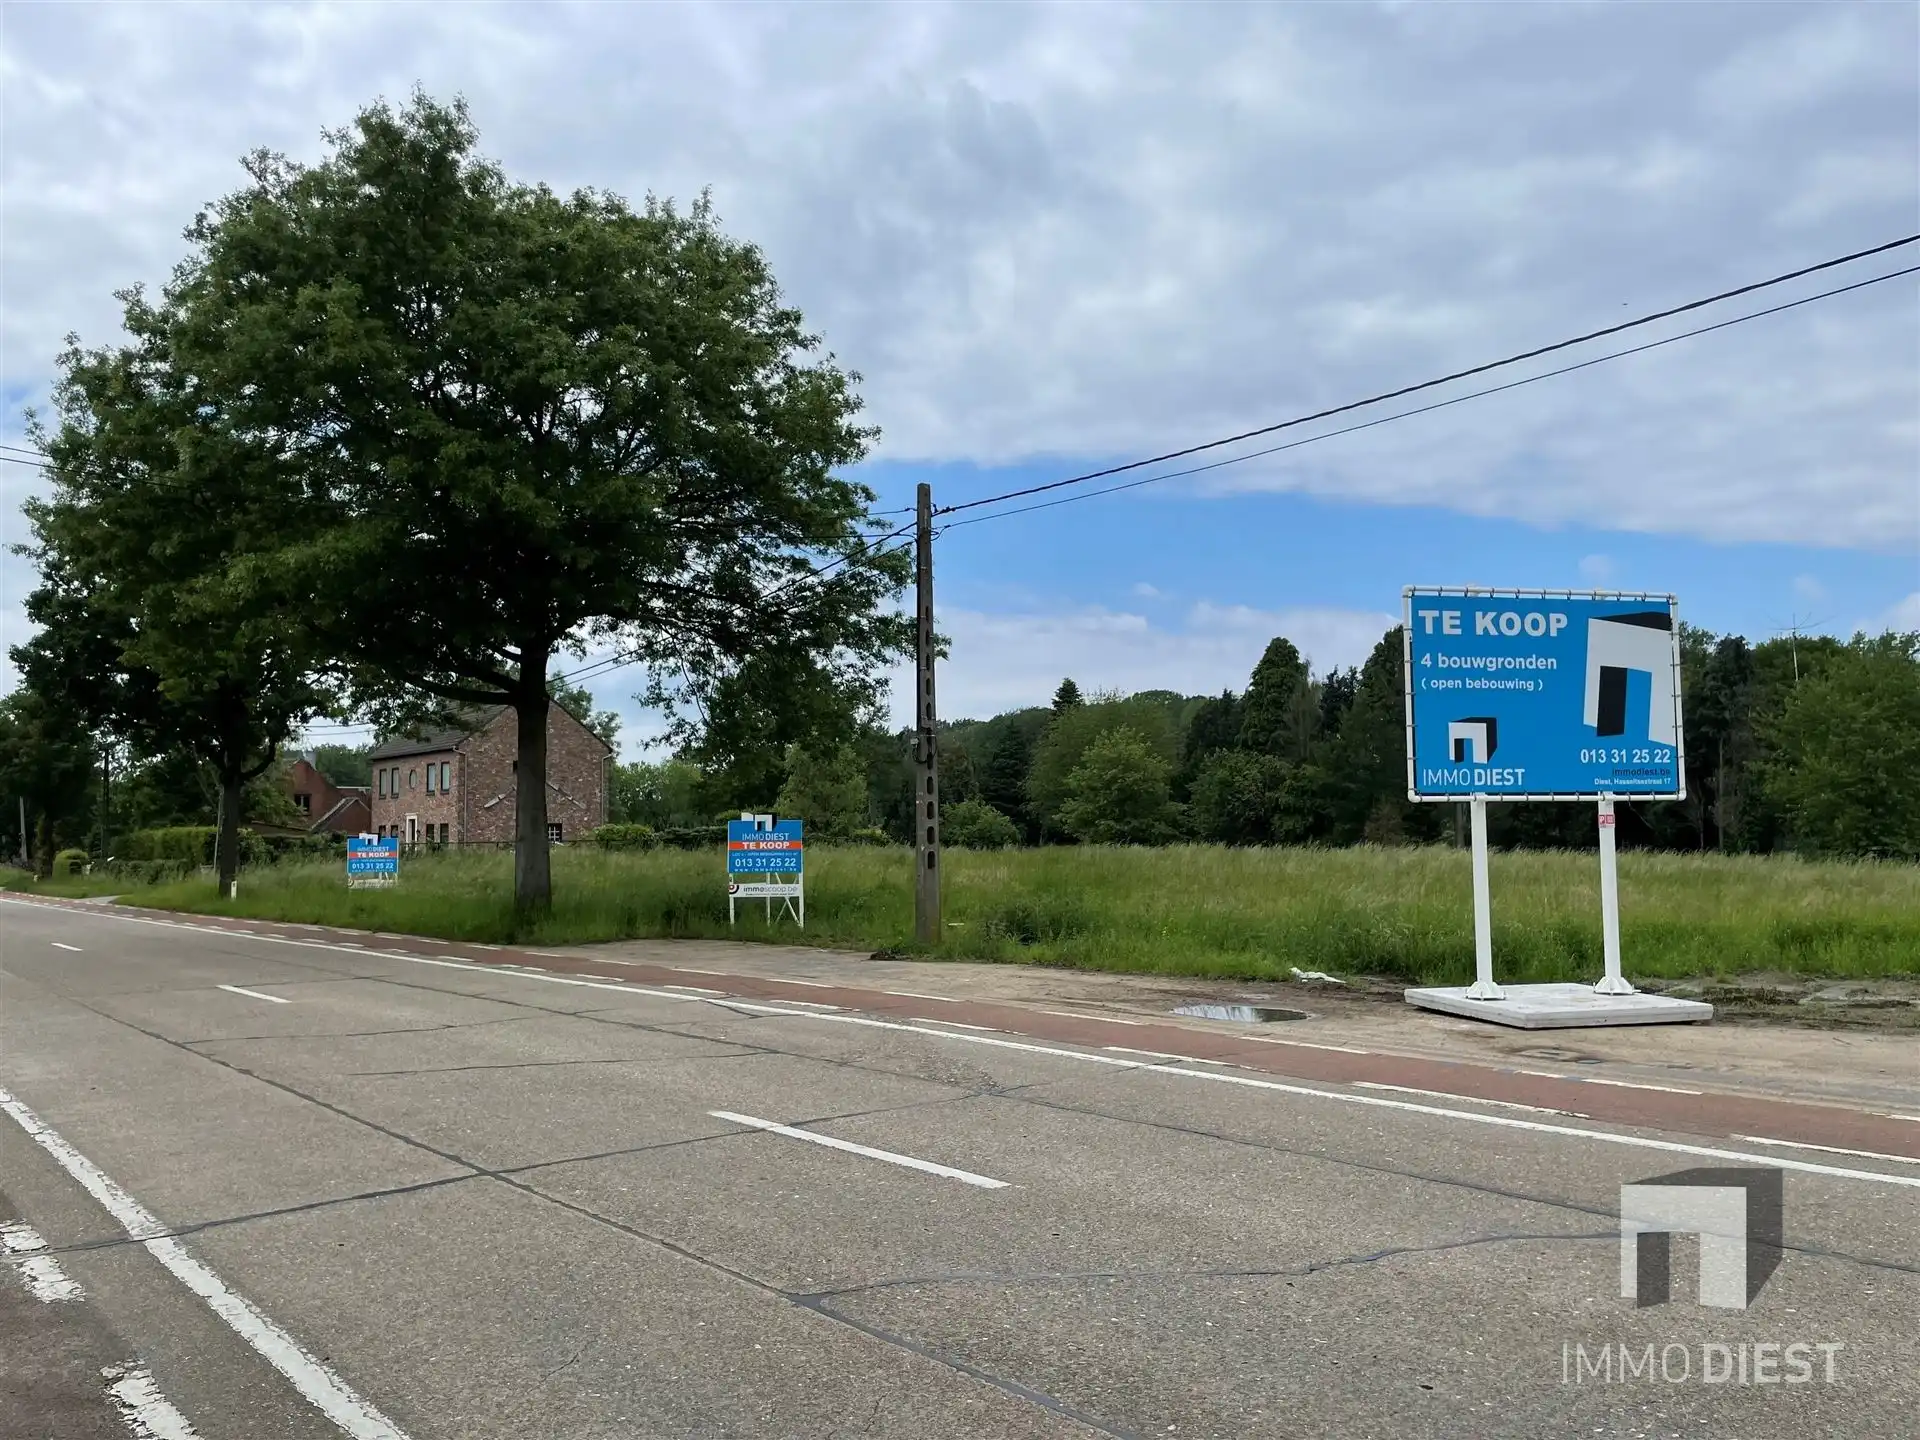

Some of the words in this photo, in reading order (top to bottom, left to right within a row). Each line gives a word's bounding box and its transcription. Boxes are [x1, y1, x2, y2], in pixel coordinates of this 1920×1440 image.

[1418, 610, 1462, 635] TE
[1475, 611, 1568, 637] KOOP
[1420, 653, 1432, 668] 4
[1438, 653, 1557, 671] bouwgronden
[1431, 679, 1462, 690] open
[1466, 678, 1534, 691] bebouwing
[1580, 749, 1606, 763] 013
[1611, 749, 1627, 763] 31
[1632, 749, 1650, 763] 25
[1654, 749, 1671, 763] 22
[1423, 768, 1471, 786] IMMO
[1474, 768, 1526, 786] DIEST
[1612, 768, 1671, 776] immodiest.be
[735, 858, 753, 867] 013
[756, 858, 766, 867] 31
[770, 858, 782, 867] 25
[784, 858, 796, 867] 22
